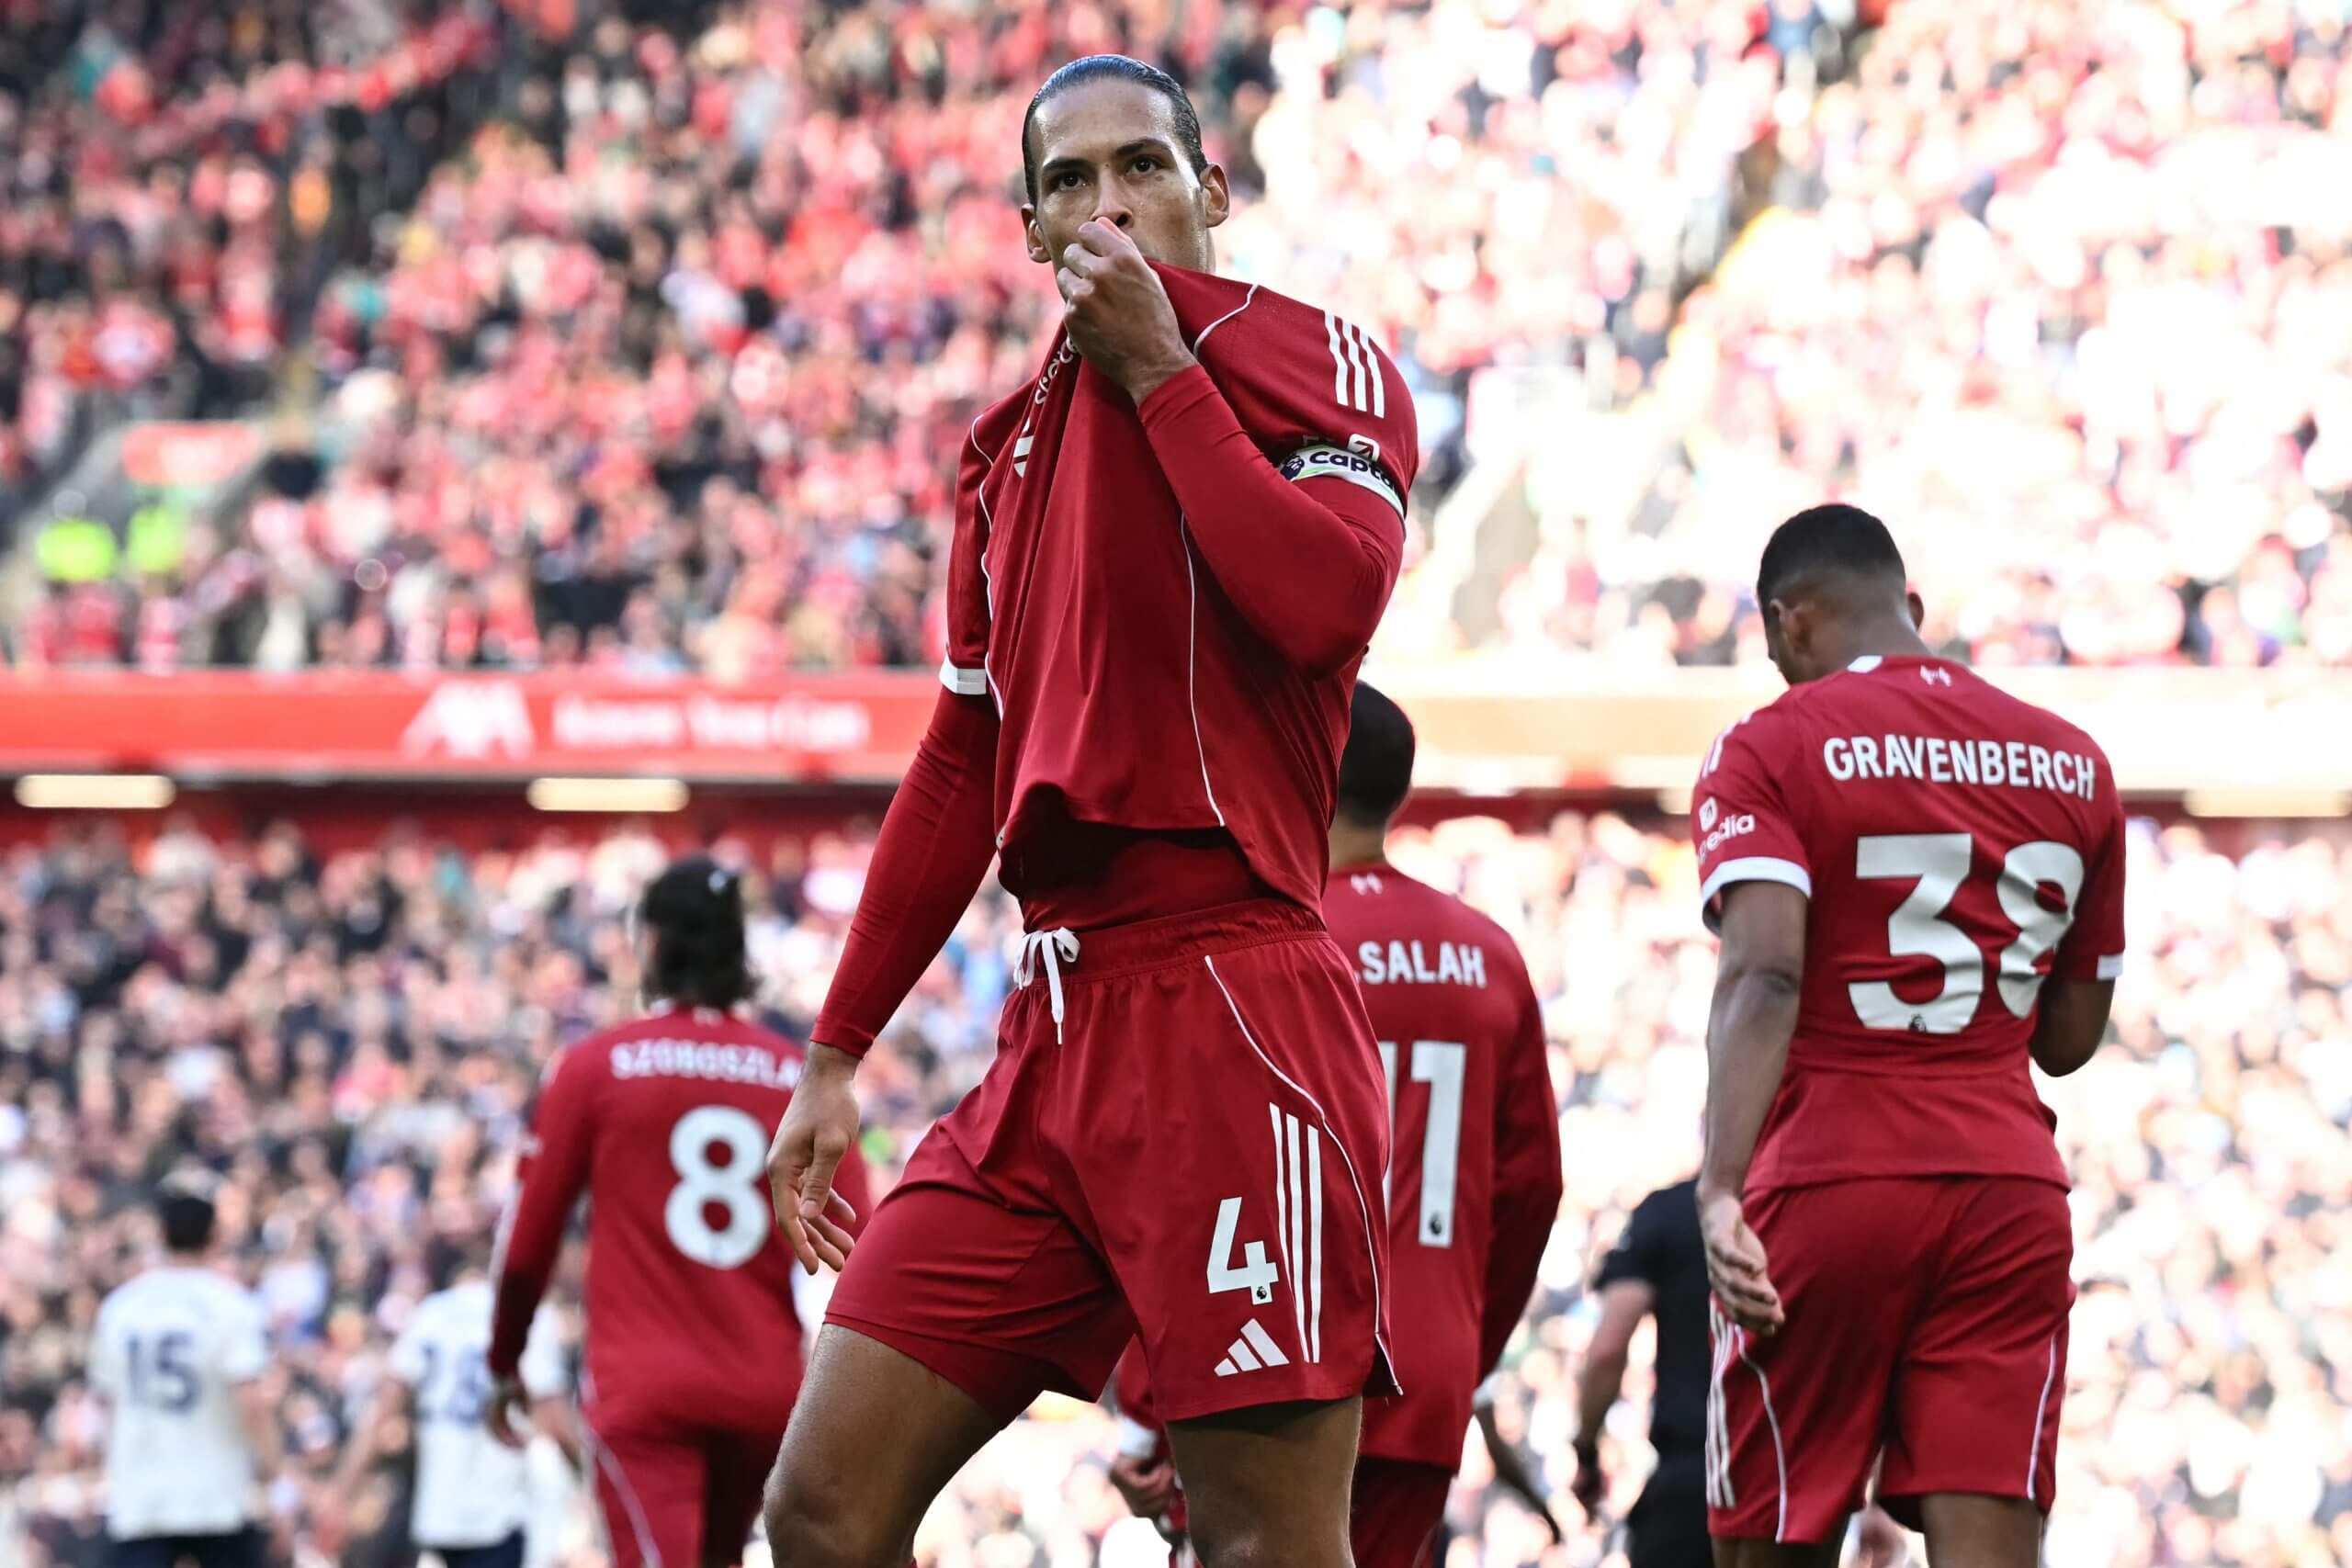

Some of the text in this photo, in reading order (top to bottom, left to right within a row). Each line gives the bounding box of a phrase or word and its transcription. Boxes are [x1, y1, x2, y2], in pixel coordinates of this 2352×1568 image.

[1824, 735, 2095, 800] GRAVENBERCH
[1849, 832, 2084, 1034] 38
[610, 1037, 802, 1090] SZOBOSZLA
[664, 1105, 769, 1269] 8
[1206, 1197, 1279, 1305] 4
[126, 1328, 200, 1415] 15
